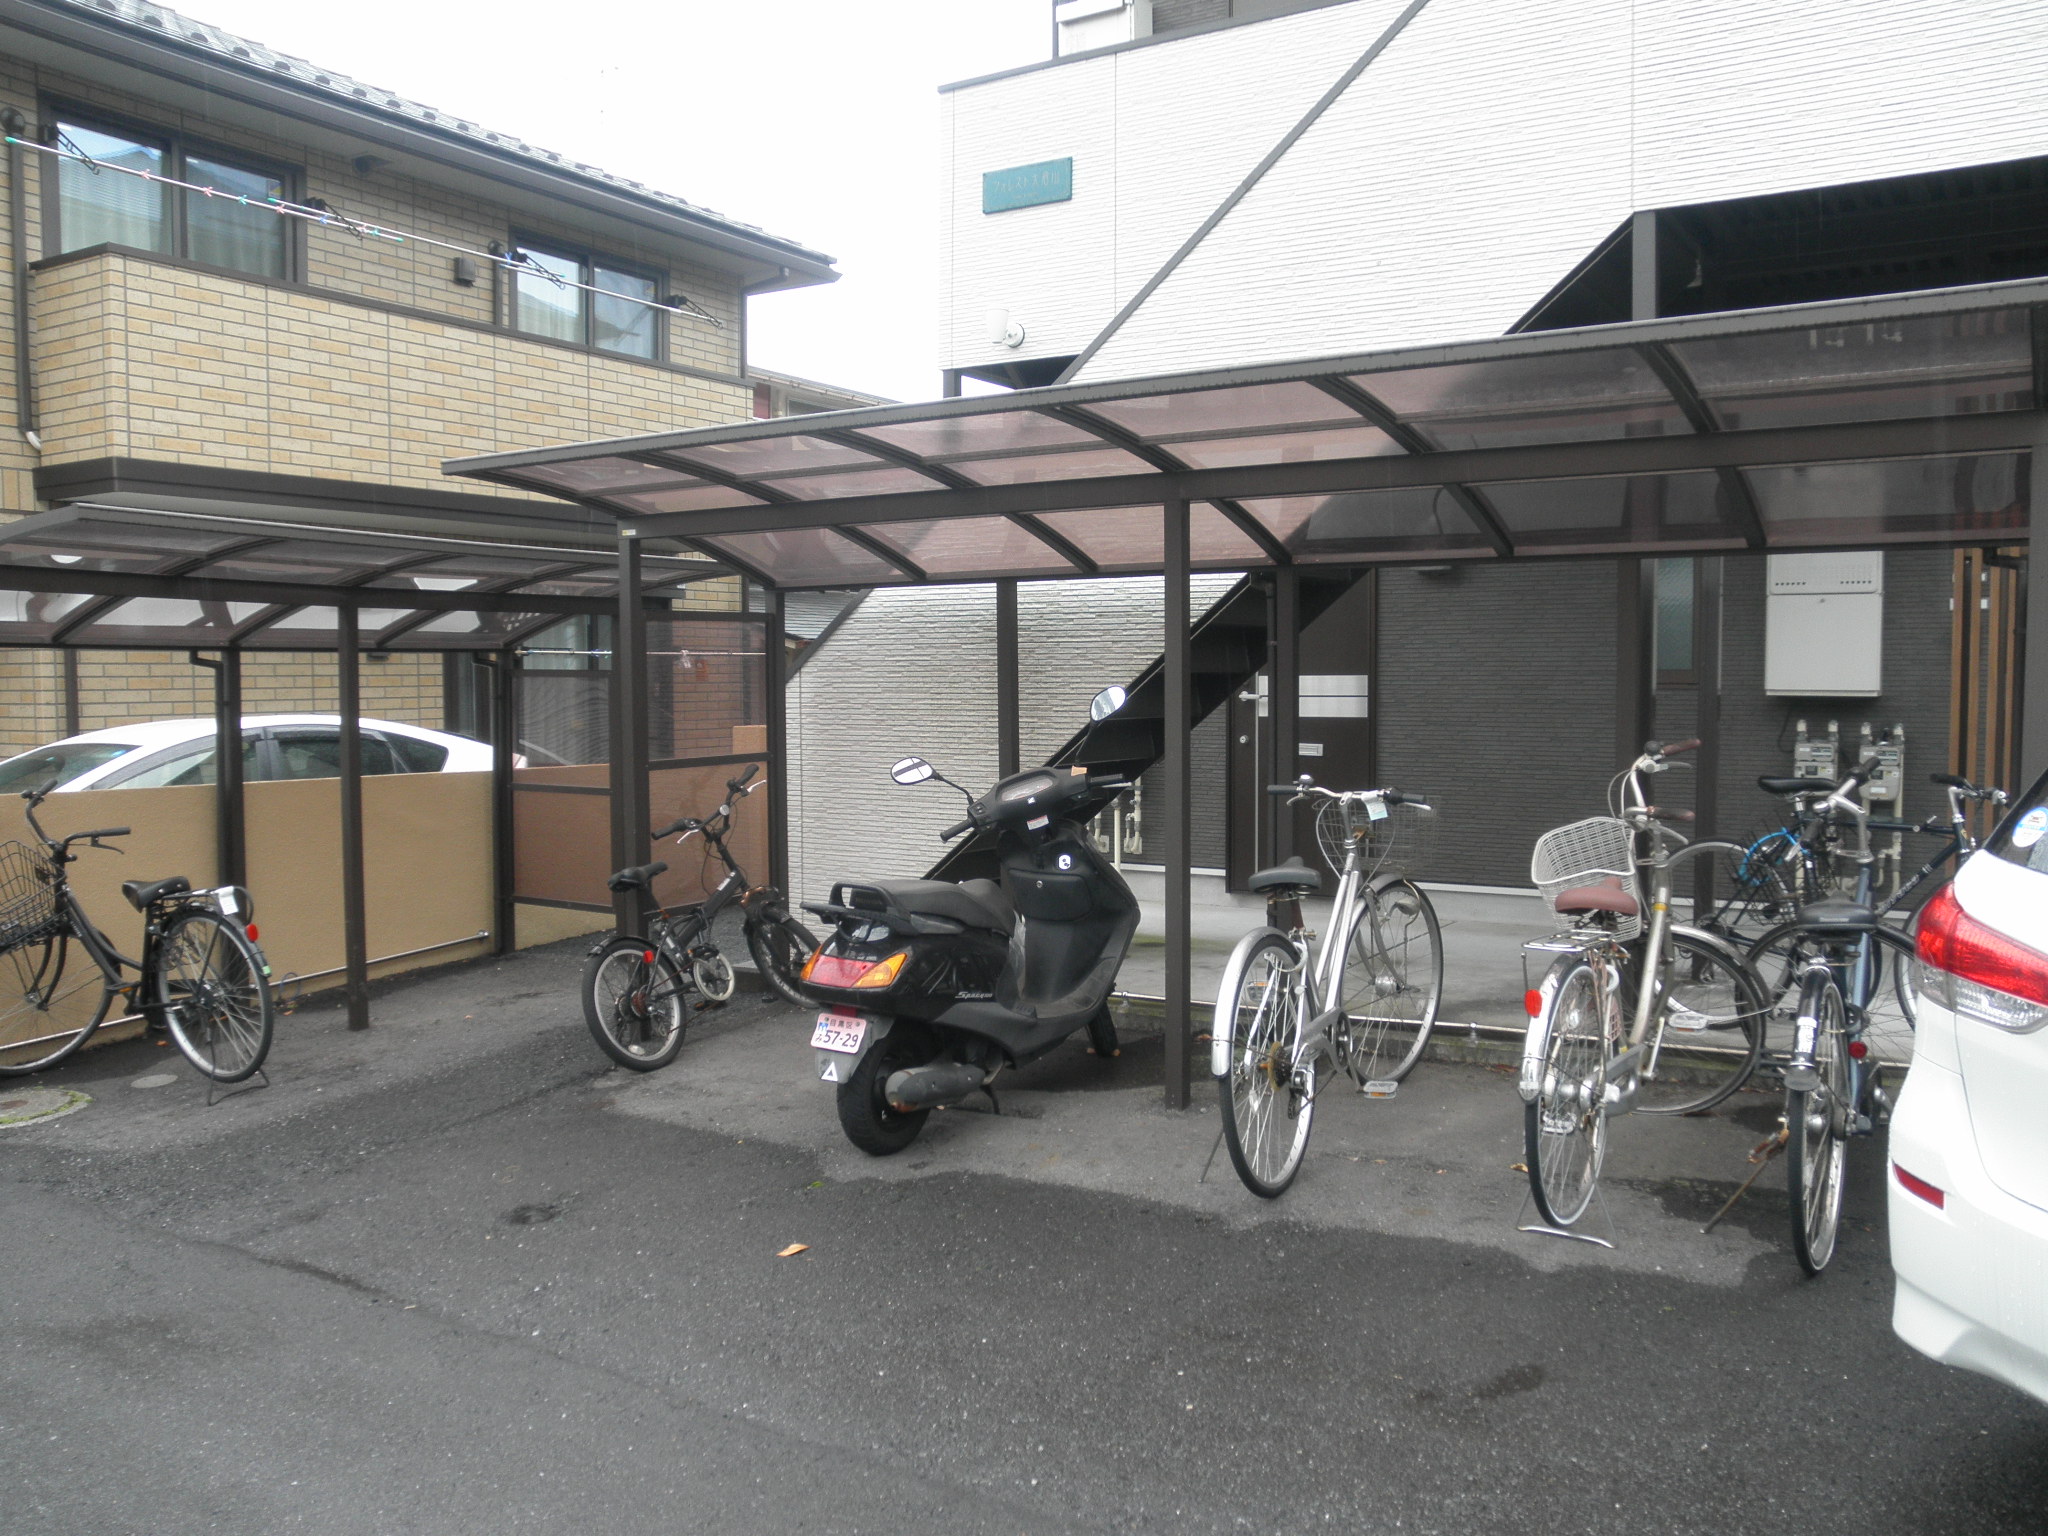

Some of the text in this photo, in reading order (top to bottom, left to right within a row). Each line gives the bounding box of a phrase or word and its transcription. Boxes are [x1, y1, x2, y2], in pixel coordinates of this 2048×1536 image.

[829, 1018, 853, 1029] 目黒区
[823, 1029, 860, 1048] 57-29
